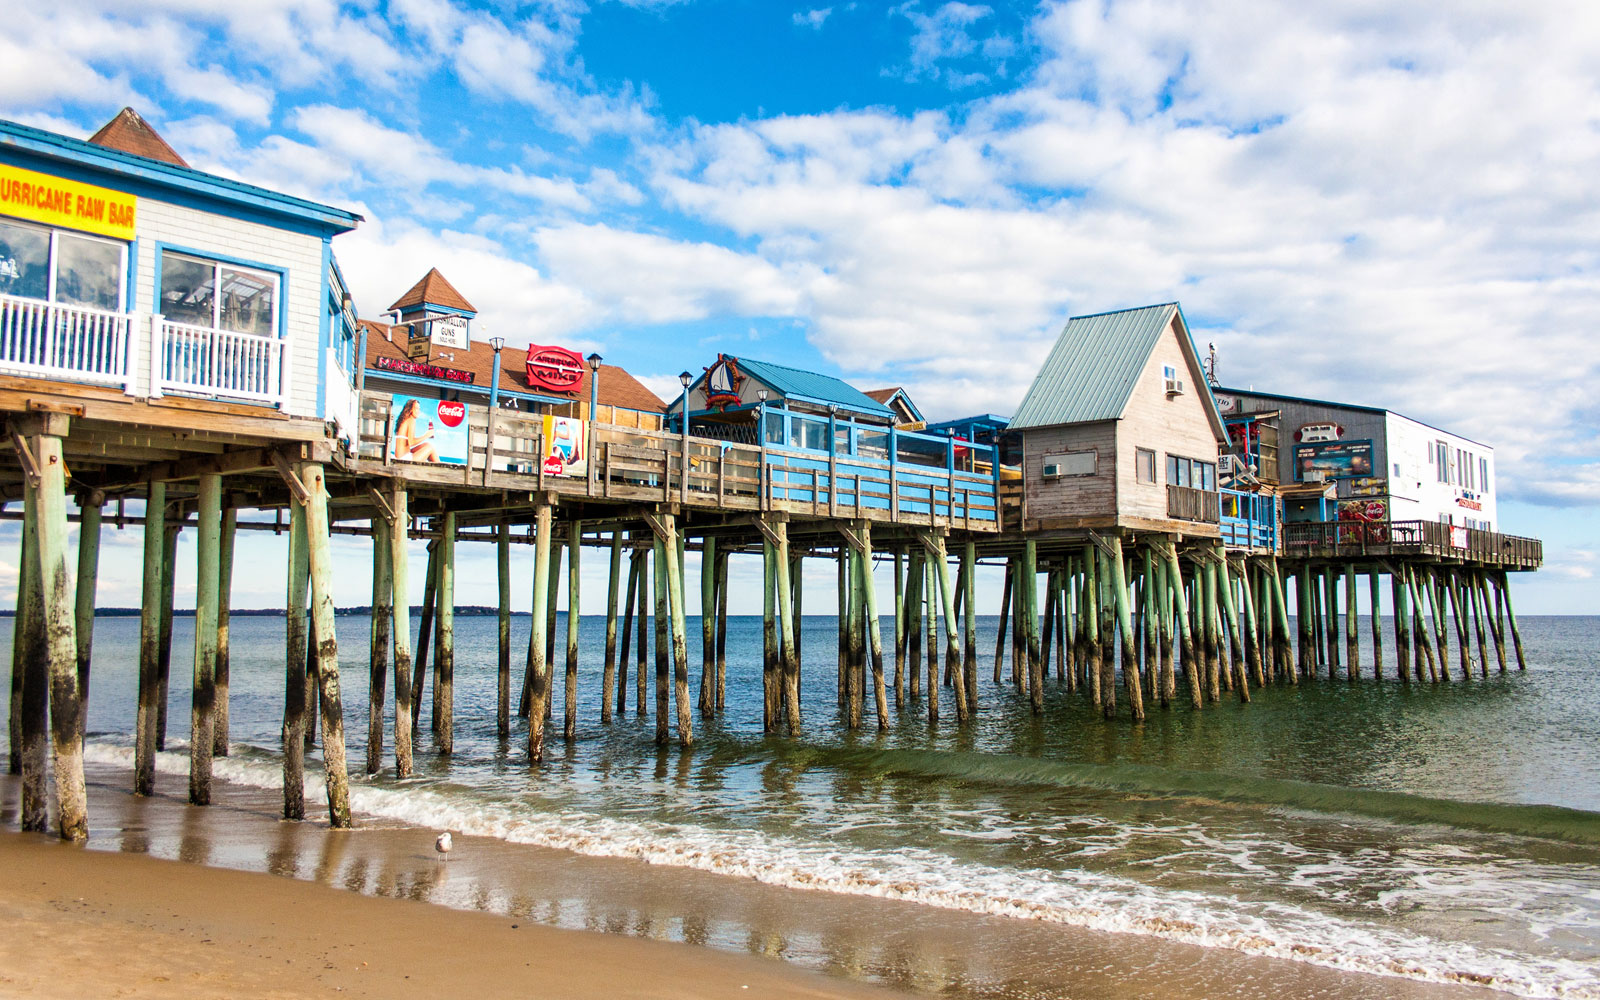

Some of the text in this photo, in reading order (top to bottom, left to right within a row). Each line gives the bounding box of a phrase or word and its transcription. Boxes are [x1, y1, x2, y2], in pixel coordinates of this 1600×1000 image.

[76, 194, 105, 222] RAW
[109, 202, 134, 228] BAR
[441, 327, 456, 337] GUNS
[446, 369, 471, 382] GUNS
[538, 370, 577, 382] MIKE
[439, 405, 464, 417] Coca-Cola
